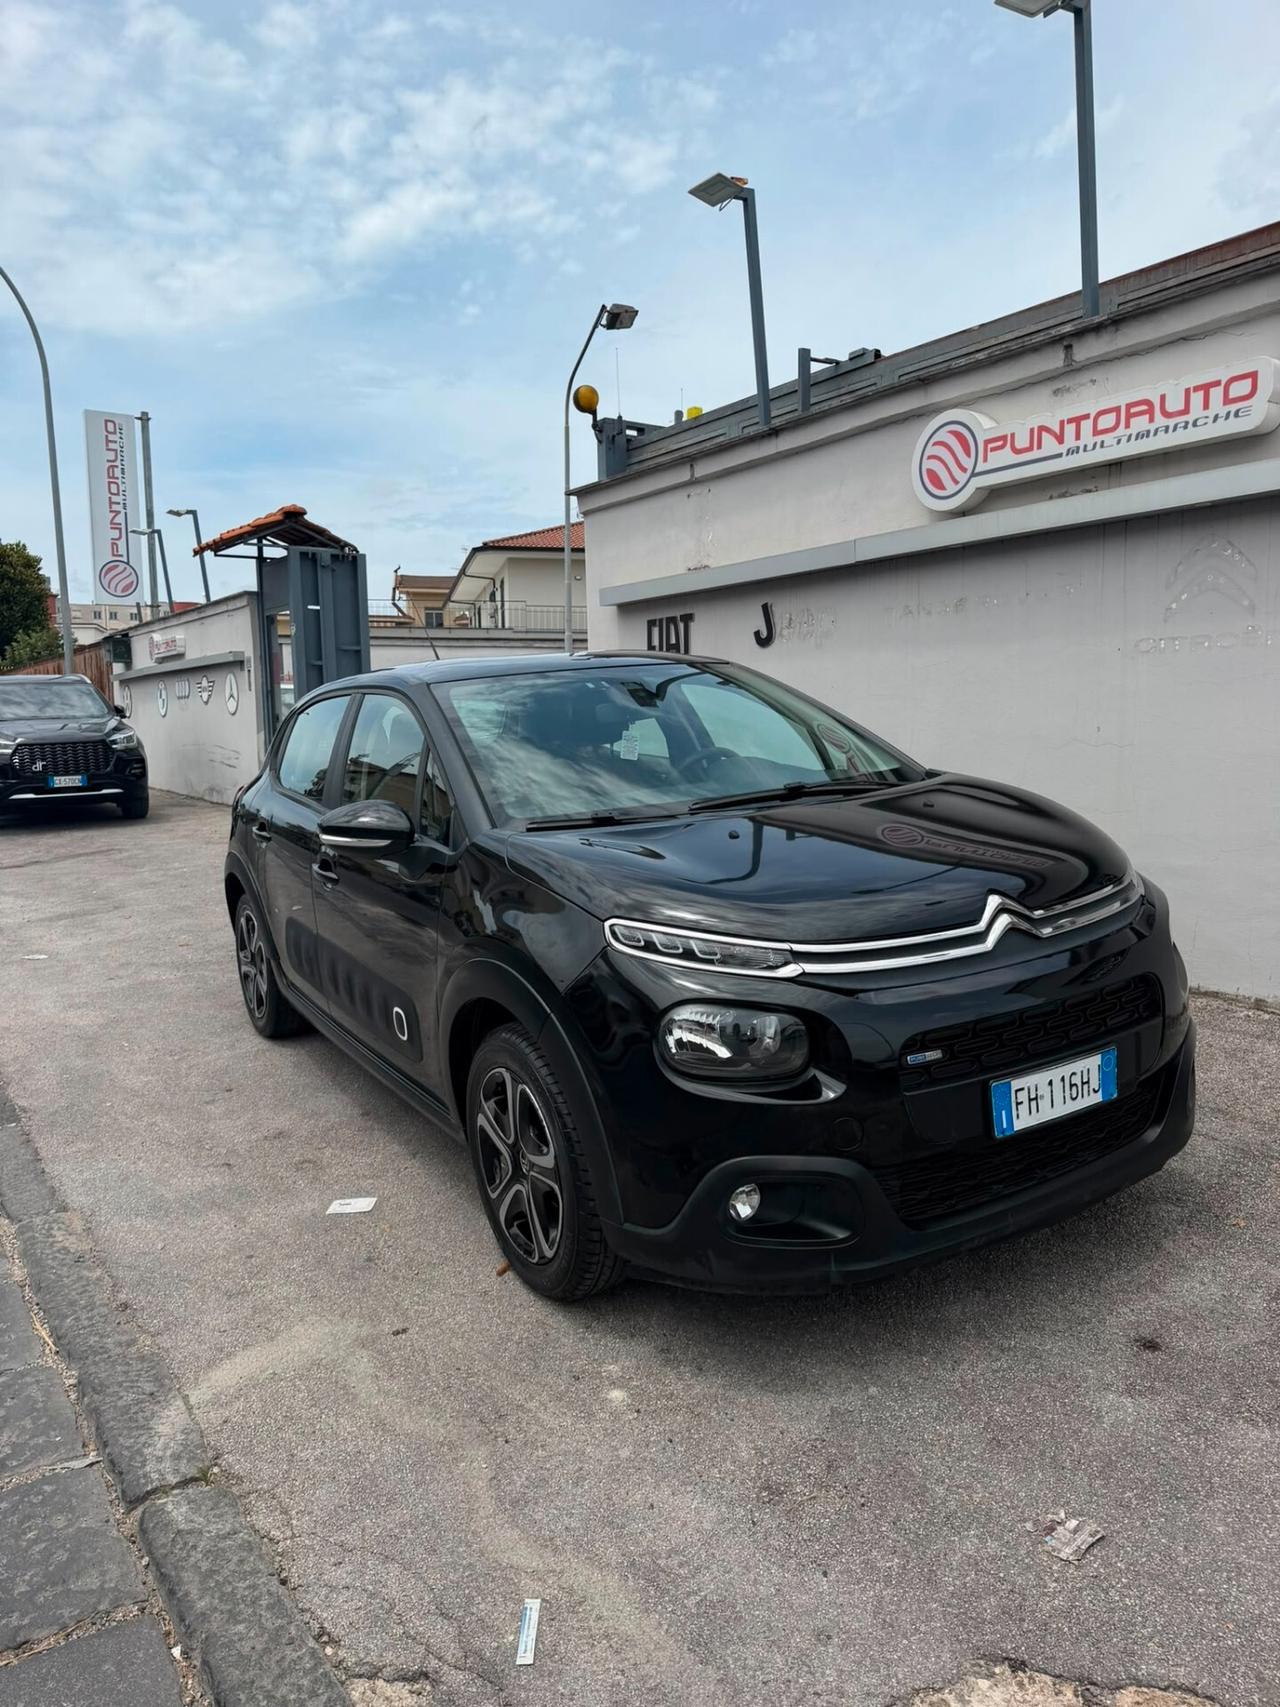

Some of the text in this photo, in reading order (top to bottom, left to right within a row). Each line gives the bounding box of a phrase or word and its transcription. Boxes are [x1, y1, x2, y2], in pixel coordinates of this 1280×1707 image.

[983, 370, 1259, 463] PUNTOAUTO
[1065, 405, 1253, 457] MULTIMARCHE
[104, 419, 123, 557] PUNTOAUTO
[647, 613, 695, 655] FIAT
